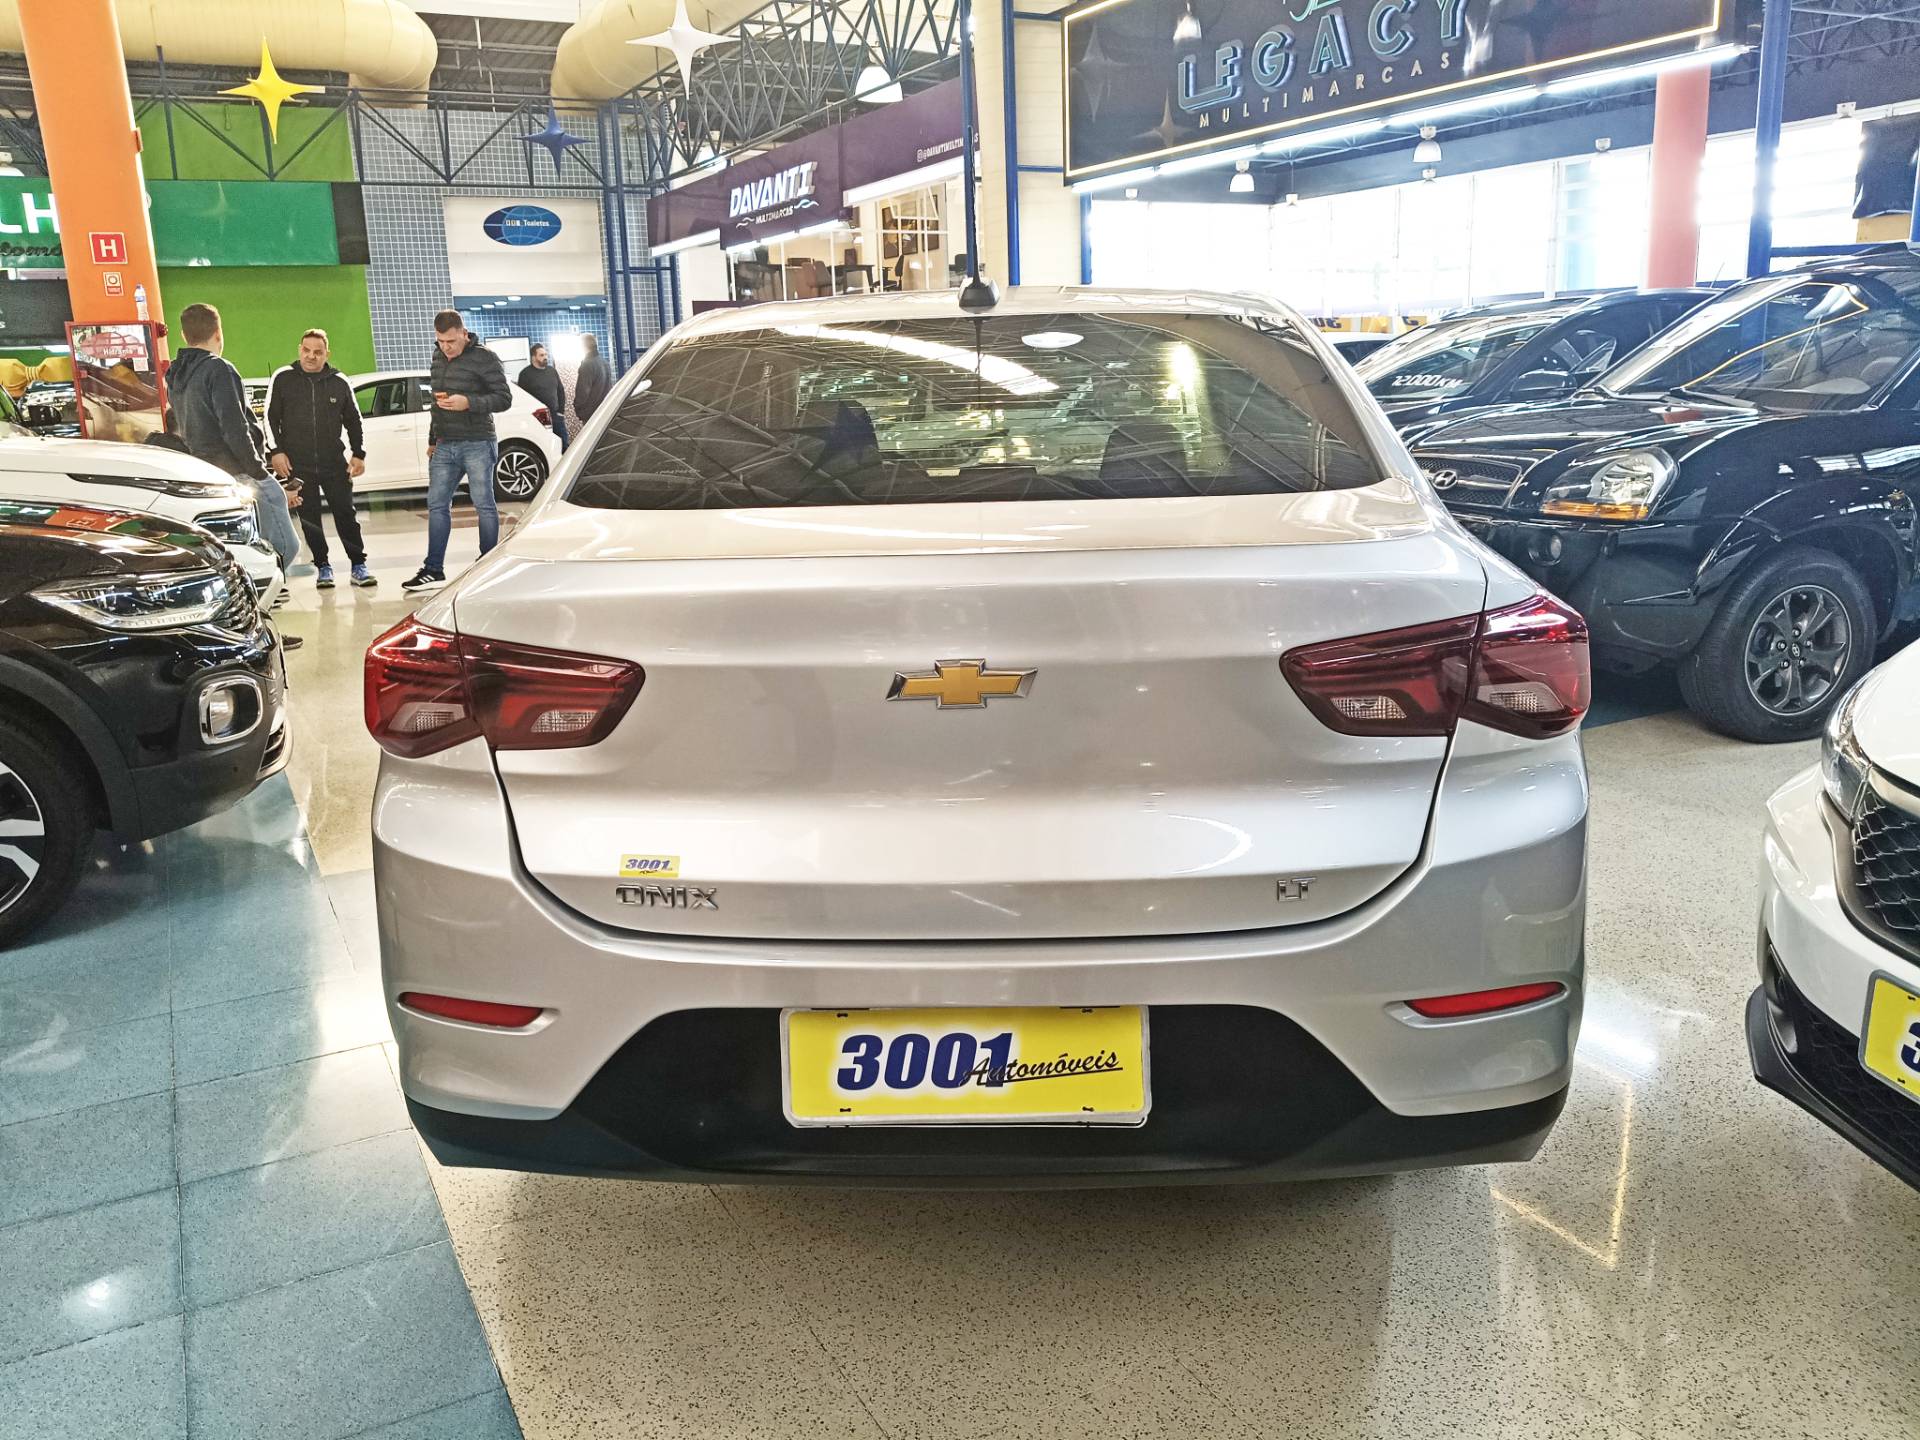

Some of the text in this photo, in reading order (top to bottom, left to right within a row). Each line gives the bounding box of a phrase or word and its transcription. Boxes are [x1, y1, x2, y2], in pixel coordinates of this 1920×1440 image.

[1178, 0, 1468, 110] LEGACY
[1199, 52, 1450, 128] MULTIMARCAS
[730, 161, 817, 218] DAVANTI
[99, 238, 118, 258] H
[625, 858, 671, 871] 3001
[615, 883, 720, 911] ONIX
[1276, 876, 1317, 903] LT
[837, 1032, 1121, 1091] 3001 Automóveis
